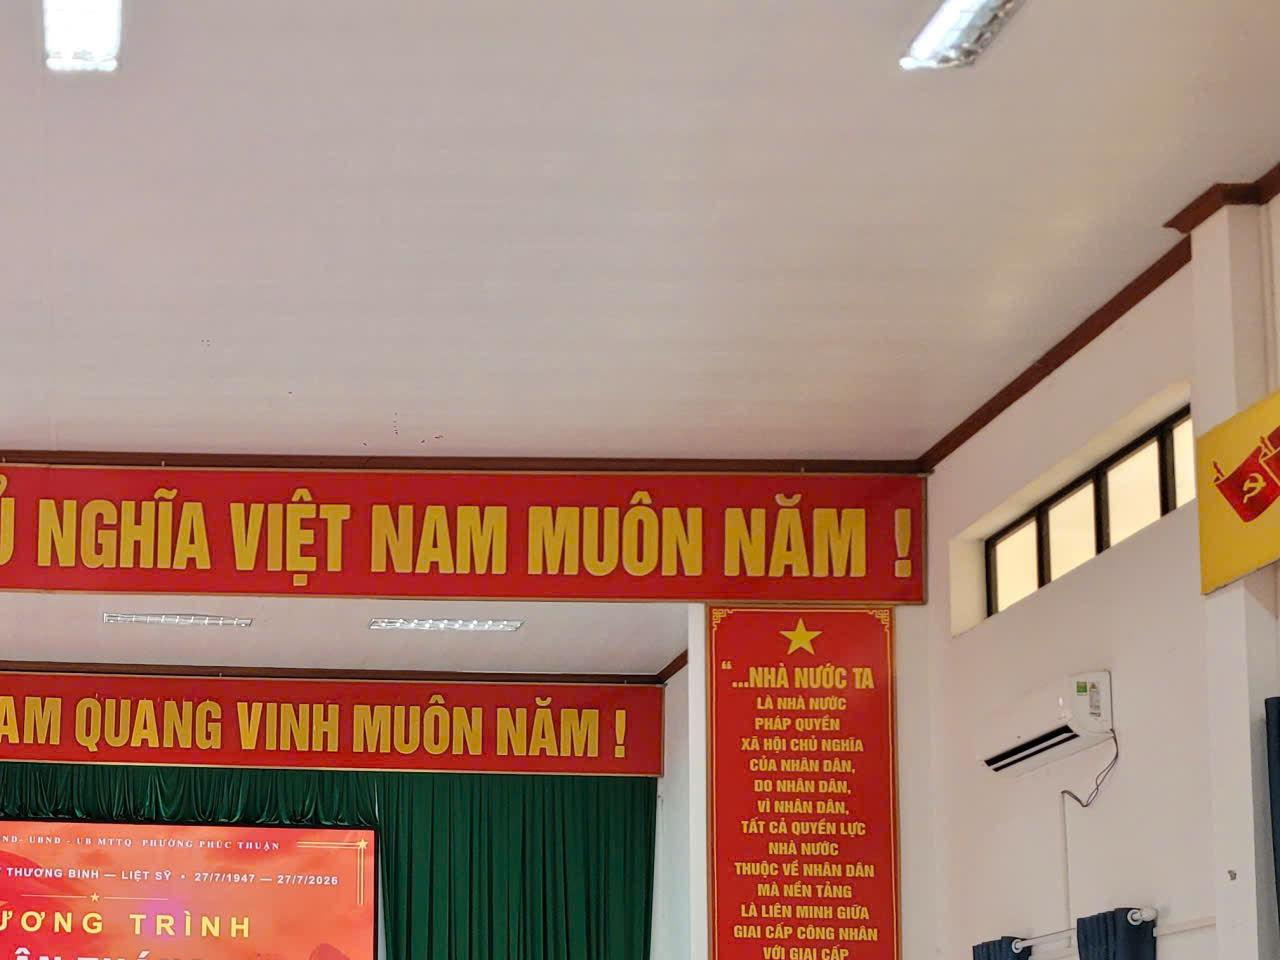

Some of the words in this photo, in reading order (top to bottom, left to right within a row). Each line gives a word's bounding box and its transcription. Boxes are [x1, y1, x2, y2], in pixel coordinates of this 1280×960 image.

[36, 488, 212, 573] NGHĨA
[229, 488, 351, 587] VIỆT
[371, 505, 508, 576] NAM
[527, 490, 704, 578] MUÔN
[723, 492, 867, 578] NĂM
[852, 668, 874, 689] TA
[74, 697, 223, 756] QUANG
[236, 702, 341, 753] VINH
[352, 694, 493, 757] MUÔN
[505, 698, 599, 758] NĂM
[781, 758, 819, 772] NHÂN
[824, 758, 855, 773] DÂN,
[754, 780, 772, 792] DO
[777, 778, 815, 792] NHÂN
[819, 778, 851, 794] DÂN,
[774, 799, 813, 814] NHÂN
[817, 799, 849, 815] DÂN,
[769, 840, 797, 855] NHÀ
[7, 867, 62, 878] THƯƠNG
[68, 869, 99, 878] BINH
[121, 869, 150, 882] LIỆT
[195, 872, 256, 883] 27/7/1947
[277, 874, 338, 885] 27/7/2026
[762, 903, 792, 918] LIÊN
[796, 906, 833, 919] MINH
[129, 911, 251, 938] TRÌNH
[734, 926, 761, 938] GIAI
[797, 925, 835, 940] CÔNG
[839, 926, 877, 941] NHÂN
[764, 945, 785, 960] VỚI
[790, 948, 817, 960] GIAI
